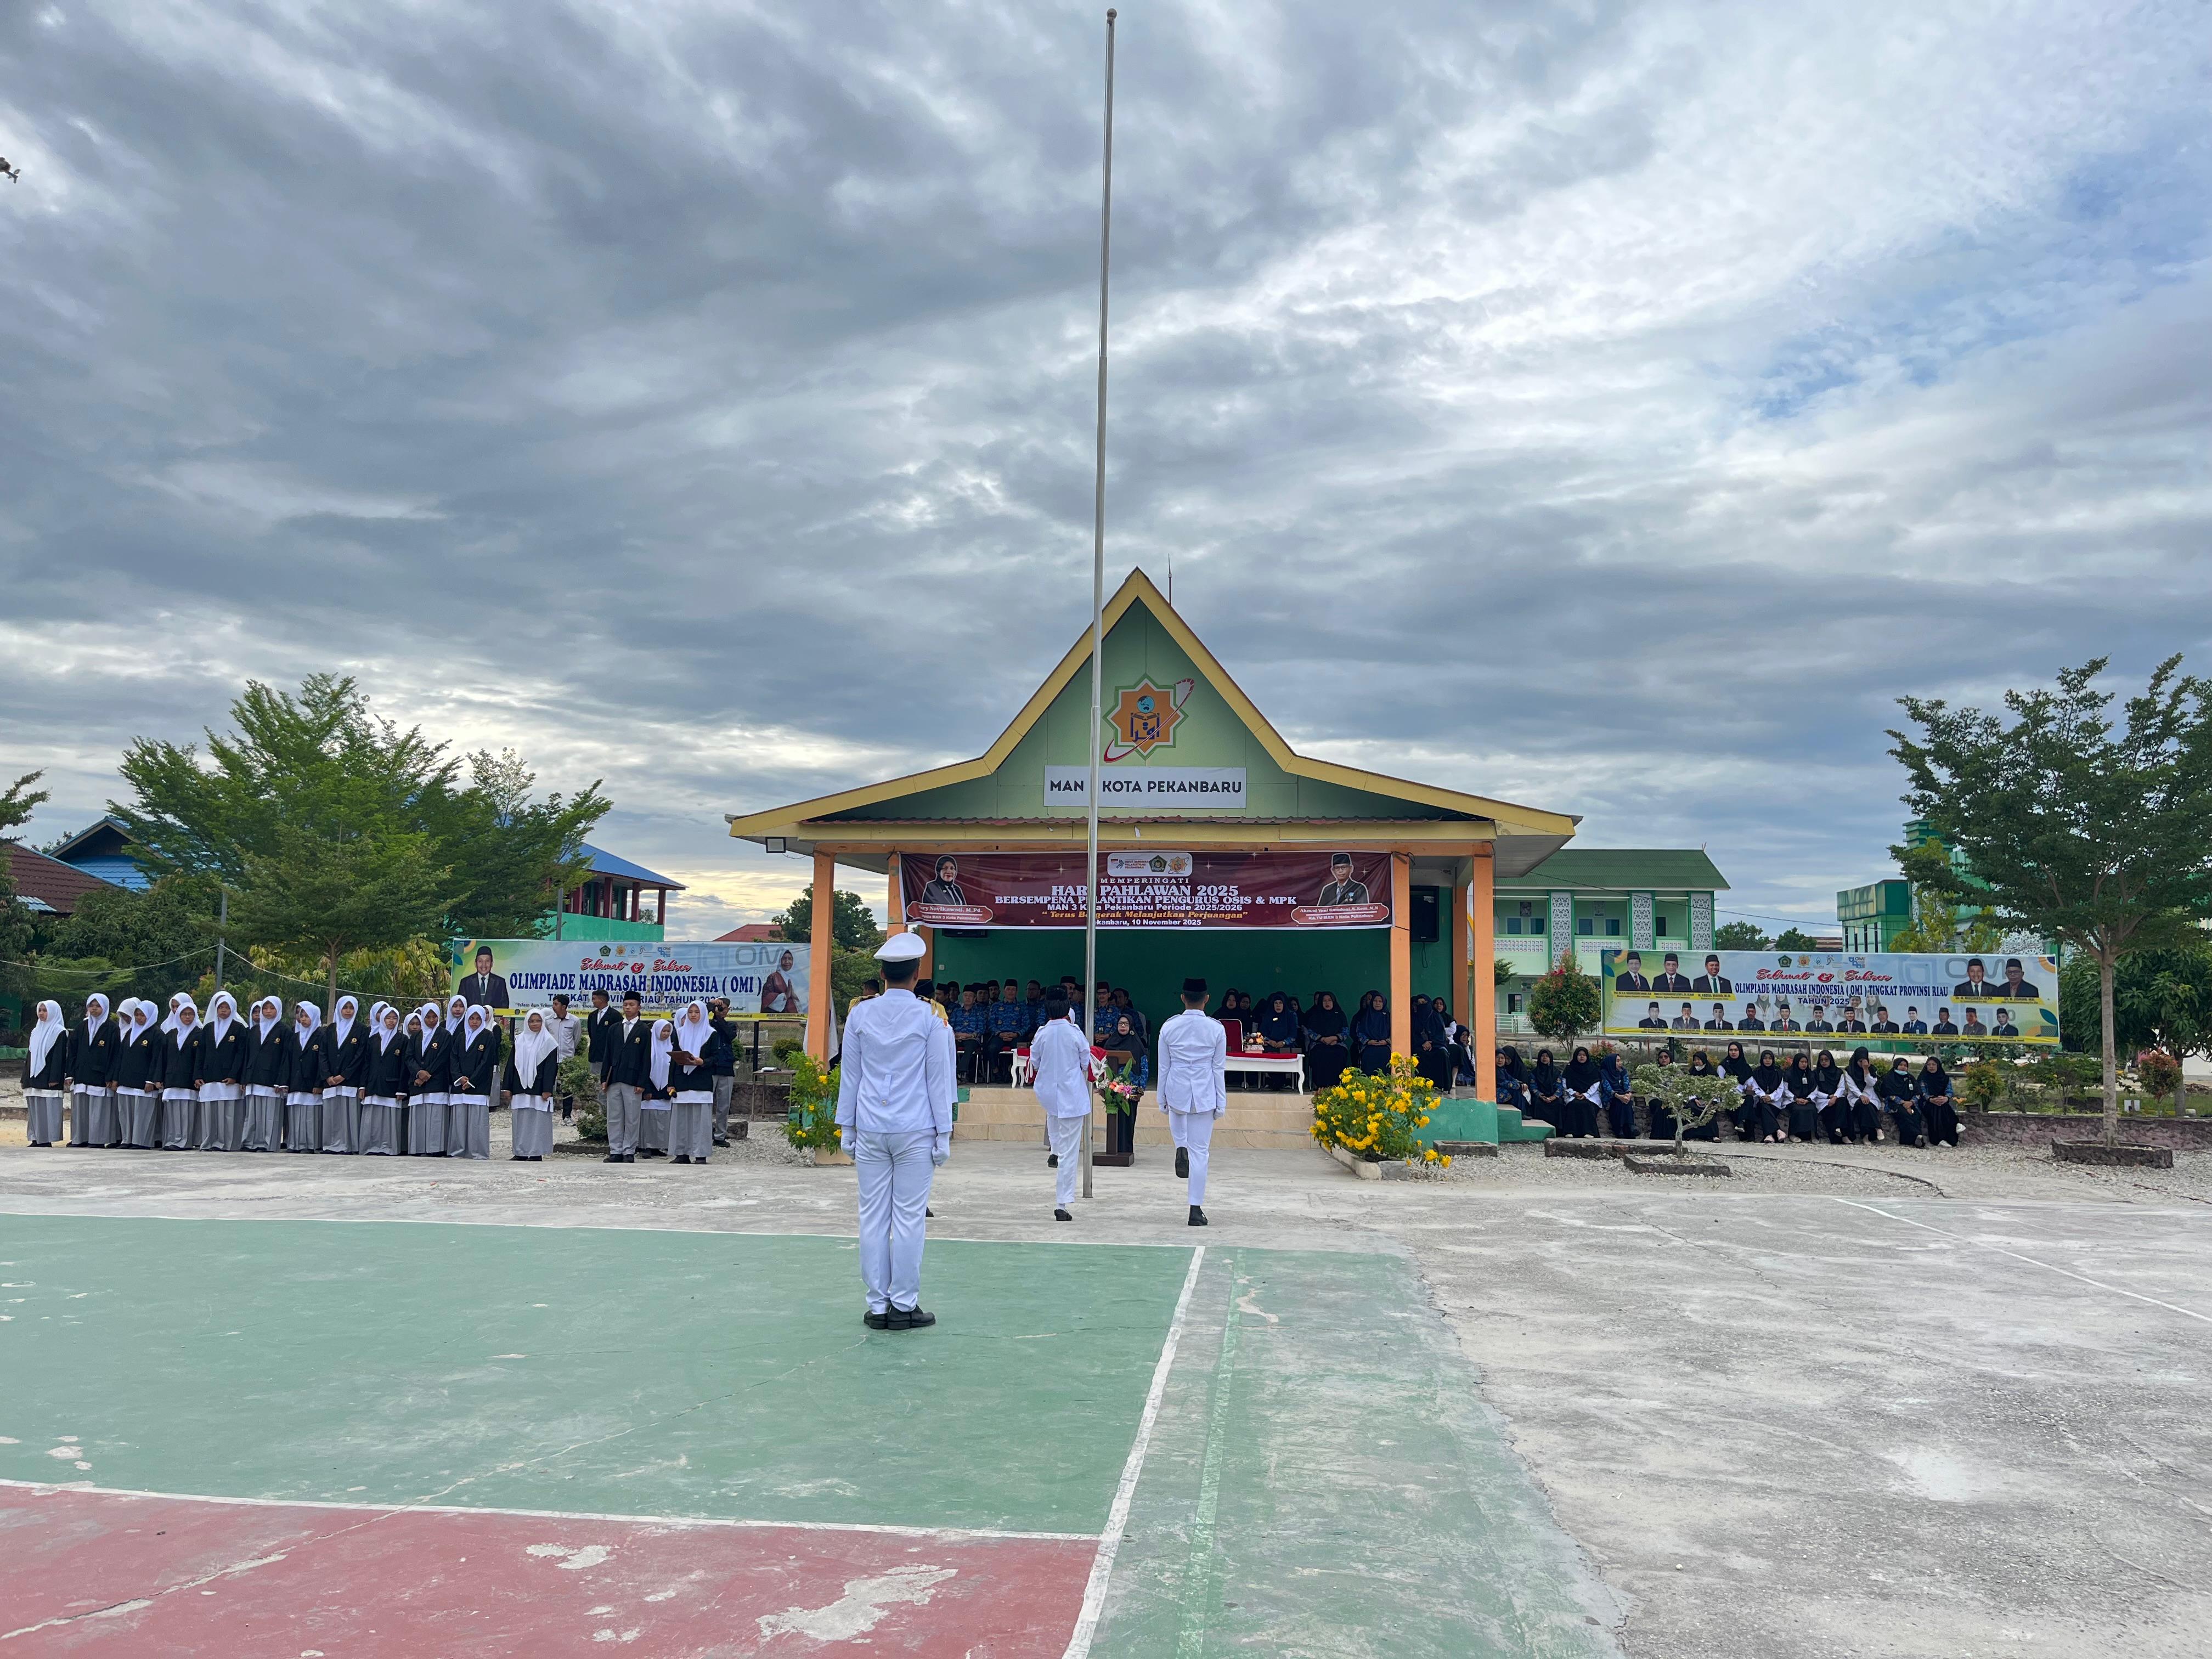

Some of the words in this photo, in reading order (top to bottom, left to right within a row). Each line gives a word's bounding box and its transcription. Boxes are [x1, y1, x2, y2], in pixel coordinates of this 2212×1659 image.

[1050, 780, 1084, 792] MAN
[1103, 781, 1142, 792] KOTA
[1147, 781, 1242, 793] PEKANBARU
[1051, 885, 1088, 896] HAR
[1100, 885, 1192, 896] PAHLAWAN
[1197, 885, 1239, 896] 2025
[995, 896, 1075, 904] BERSEMPENA
[1077, 896, 1152, 904] PLANTIKAN
[1154, 896, 1220, 904] PENGURUS
[1223, 896, 1252, 904] OSIS
[1255, 896, 1265, 904] &
[1269, 896, 1297, 905] MPK
[1124, 911, 1184, 919] Melanjutkan
[580, 957, 629, 971] Selamat
[631, 962, 645, 974] &
[652, 959, 692, 972] Sukses
[1756, 969, 1814, 980] Selamat
[1817, 973, 1835, 983] &
[1844, 970, 1893, 982] Sukses
[510, 972, 575, 990] OLIMPIADE
[579, 974, 647, 991] MADRASAH
[650, 975, 719, 993] INDONESIA
[731, 975, 754, 993] OMI
[1735, 983, 1770, 994] OLIMPIADE
[1771, 983, 1807, 995] MADRASAH
[1809, 984, 1844, 995] INDONESIA
[1850, 985, 1863, 995] OMI
[1869, 985, 1898, 996] TINGKAT
[1899, 985, 1931, 997] PROVINSI
[1932, 986, 1948, 997] RIAU
[548, 994, 589, 1002] TKAT
[640, 995, 661, 1003] RIAU
